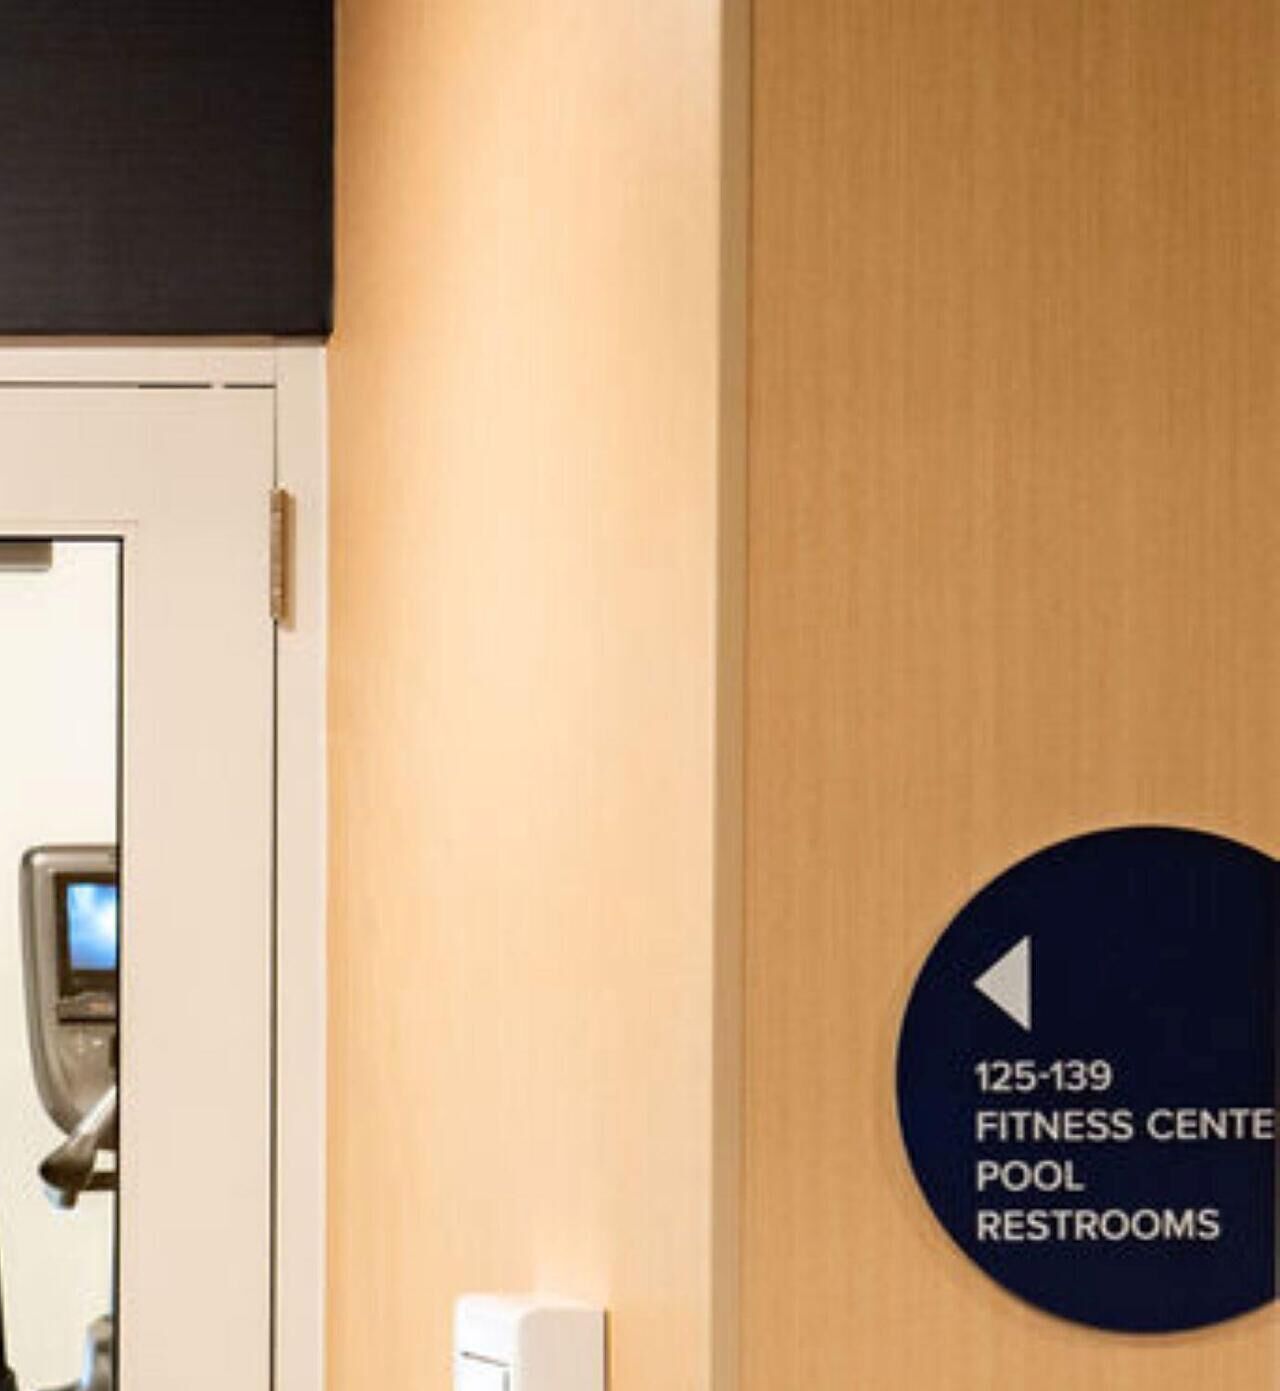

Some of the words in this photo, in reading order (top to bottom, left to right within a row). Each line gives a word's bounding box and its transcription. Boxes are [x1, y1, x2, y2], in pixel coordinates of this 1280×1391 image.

[975, 1059, 1113, 1092] 125-139
[976, 1109, 1134, 1142] FITNESS
[1146, 1108, 1274, 1140] CENTE
[977, 1159, 1085, 1192] POOL
[977, 1208, 1220, 1241] RESTROOMS
